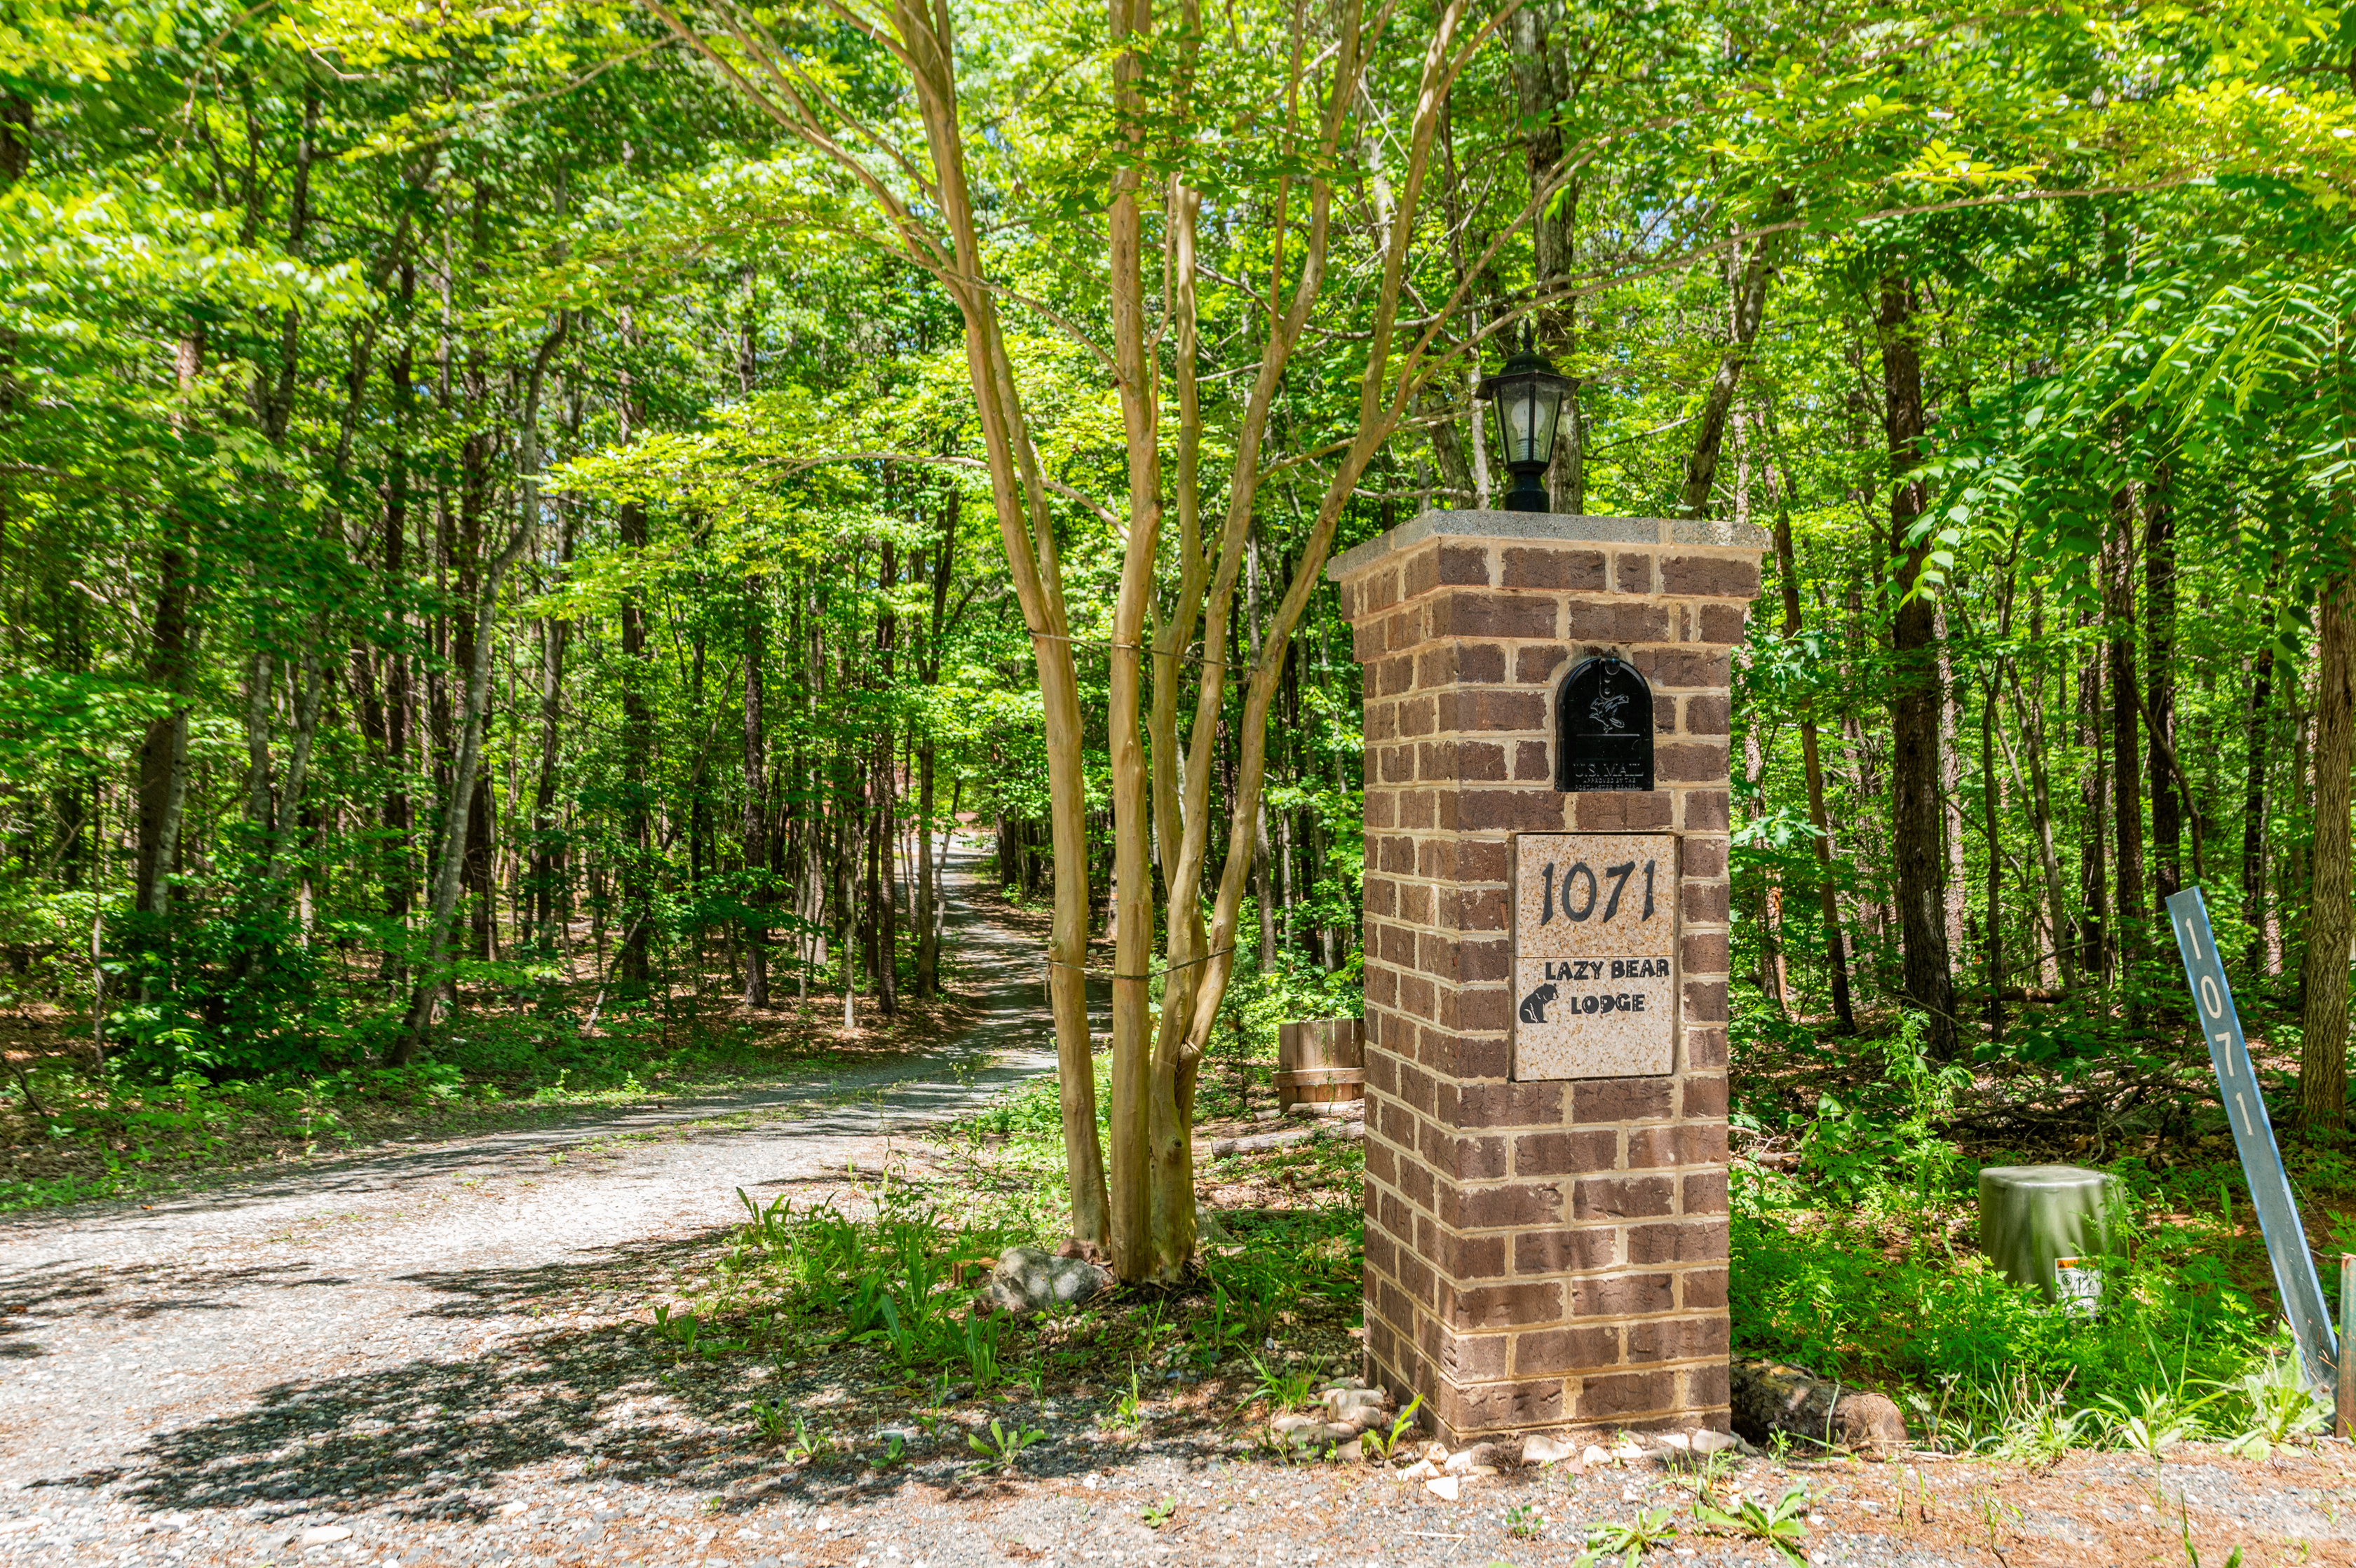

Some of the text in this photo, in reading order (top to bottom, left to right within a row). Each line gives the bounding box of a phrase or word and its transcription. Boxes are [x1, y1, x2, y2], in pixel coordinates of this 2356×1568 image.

[1542, 860, 1656, 926] 1071
[1545, 959, 1670, 980] LAZY BEAR
[1571, 994, 1645, 1014] LODGE
[2185, 918, 2253, 1136] 1071
